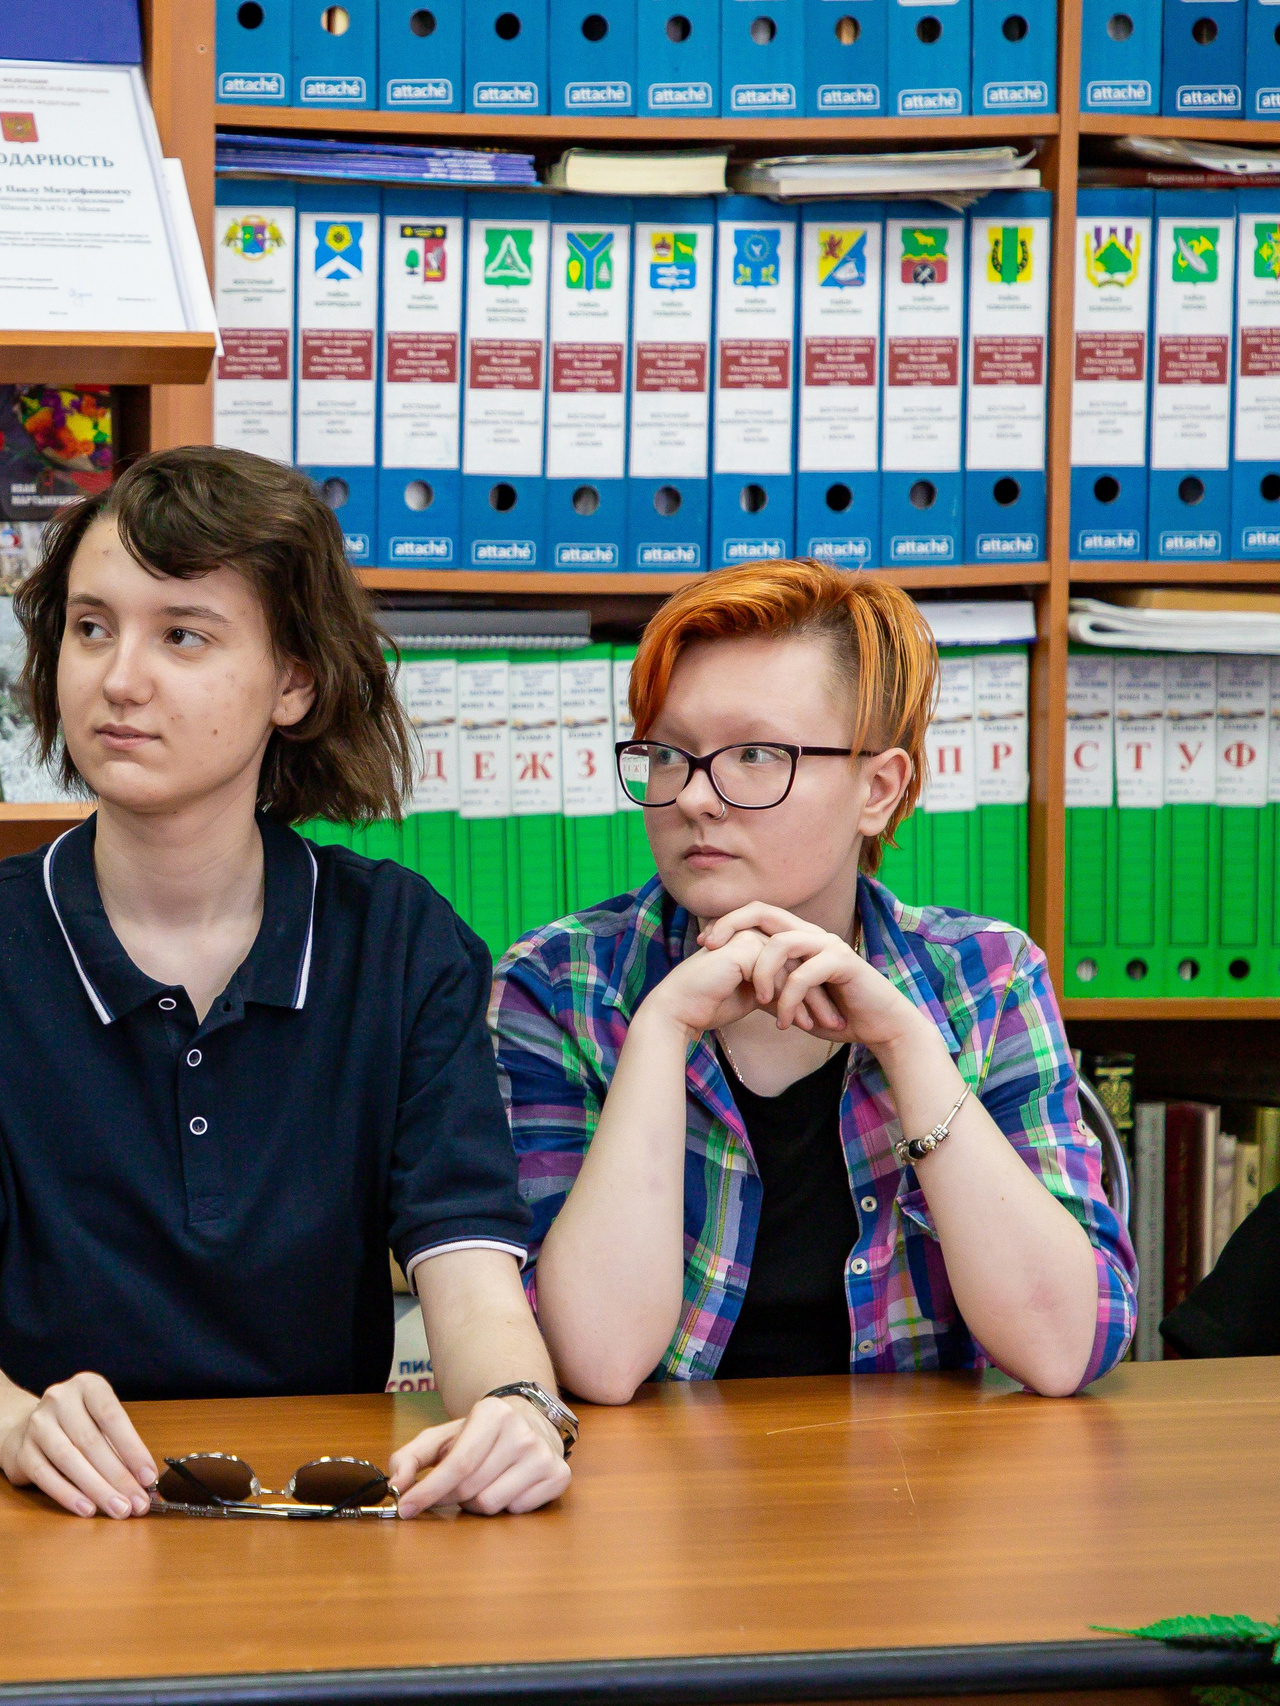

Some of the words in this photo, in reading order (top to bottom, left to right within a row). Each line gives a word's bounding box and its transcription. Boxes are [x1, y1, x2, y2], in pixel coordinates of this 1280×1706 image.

[224, 76, 279, 93] attaché
[306, 79, 361, 97] attaché
[392, 82, 447, 99] attaché
[478, 85, 533, 102] attaché
[570, 85, 625, 102] attaché
[989, 85, 1042, 102] attaché
[1092, 84, 1145, 101] attaché
[653, 86, 706, 104] attaché
[737, 87, 790, 105] attaché
[823, 87, 874, 104] attaché
[904, 92, 956, 109] attaché
[1182, 88, 1236, 105] attaché
[895, 537, 948, 555] attaché
[981, 535, 1034, 554] attaché
[1084, 533, 1136, 550] attaché
[1165, 534, 1216, 551] attaché
[1248, 531, 1280, 546] attac
[394, 539, 448, 557] attaché
[476, 542, 530, 560] attaché
[560, 545, 614, 563] attaché
[642, 545, 696, 563] attaché
[728, 541, 781, 557] attaché
[814, 540, 867, 557] attaché
[576, 749, 597, 779] З
[937, 745, 962, 774] П
[991, 742, 1013, 770] Р
[1073, 741, 1100, 772] С
[1126, 742, 1152, 771] Т
[1178, 741, 1203, 771] У
[1224, 741, 1256, 769] Ф
[420, 749, 447, 782] Д
[473, 751, 497, 780] Е
[516, 752, 554, 781] Ж
